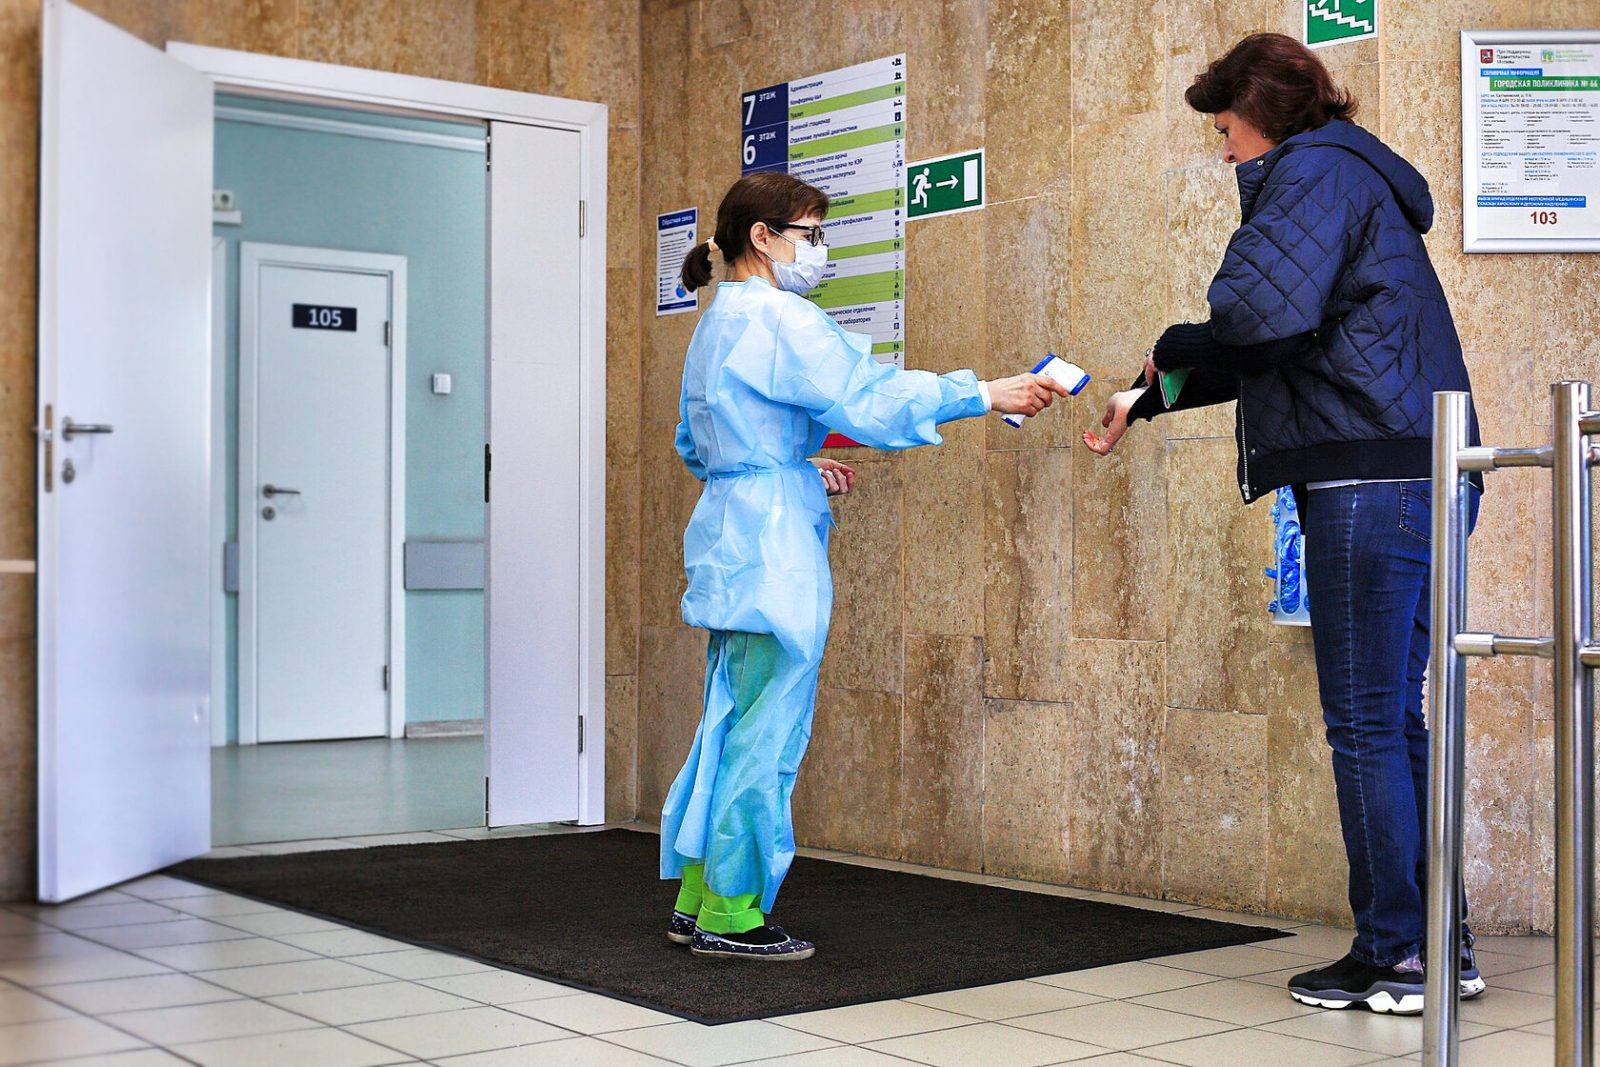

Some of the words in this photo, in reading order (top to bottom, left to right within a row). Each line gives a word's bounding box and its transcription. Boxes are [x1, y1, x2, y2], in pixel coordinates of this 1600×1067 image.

[1494, 80, 1531, 88] ГОРОДСКАЯ
[744, 94, 756, 126] 7
[759, 91, 776, 102] этаж
[744, 134, 756, 165] 6
[759, 131, 776, 142] этаж
[1530, 211, 1558, 224] 103
[308, 308, 342, 328] 105
